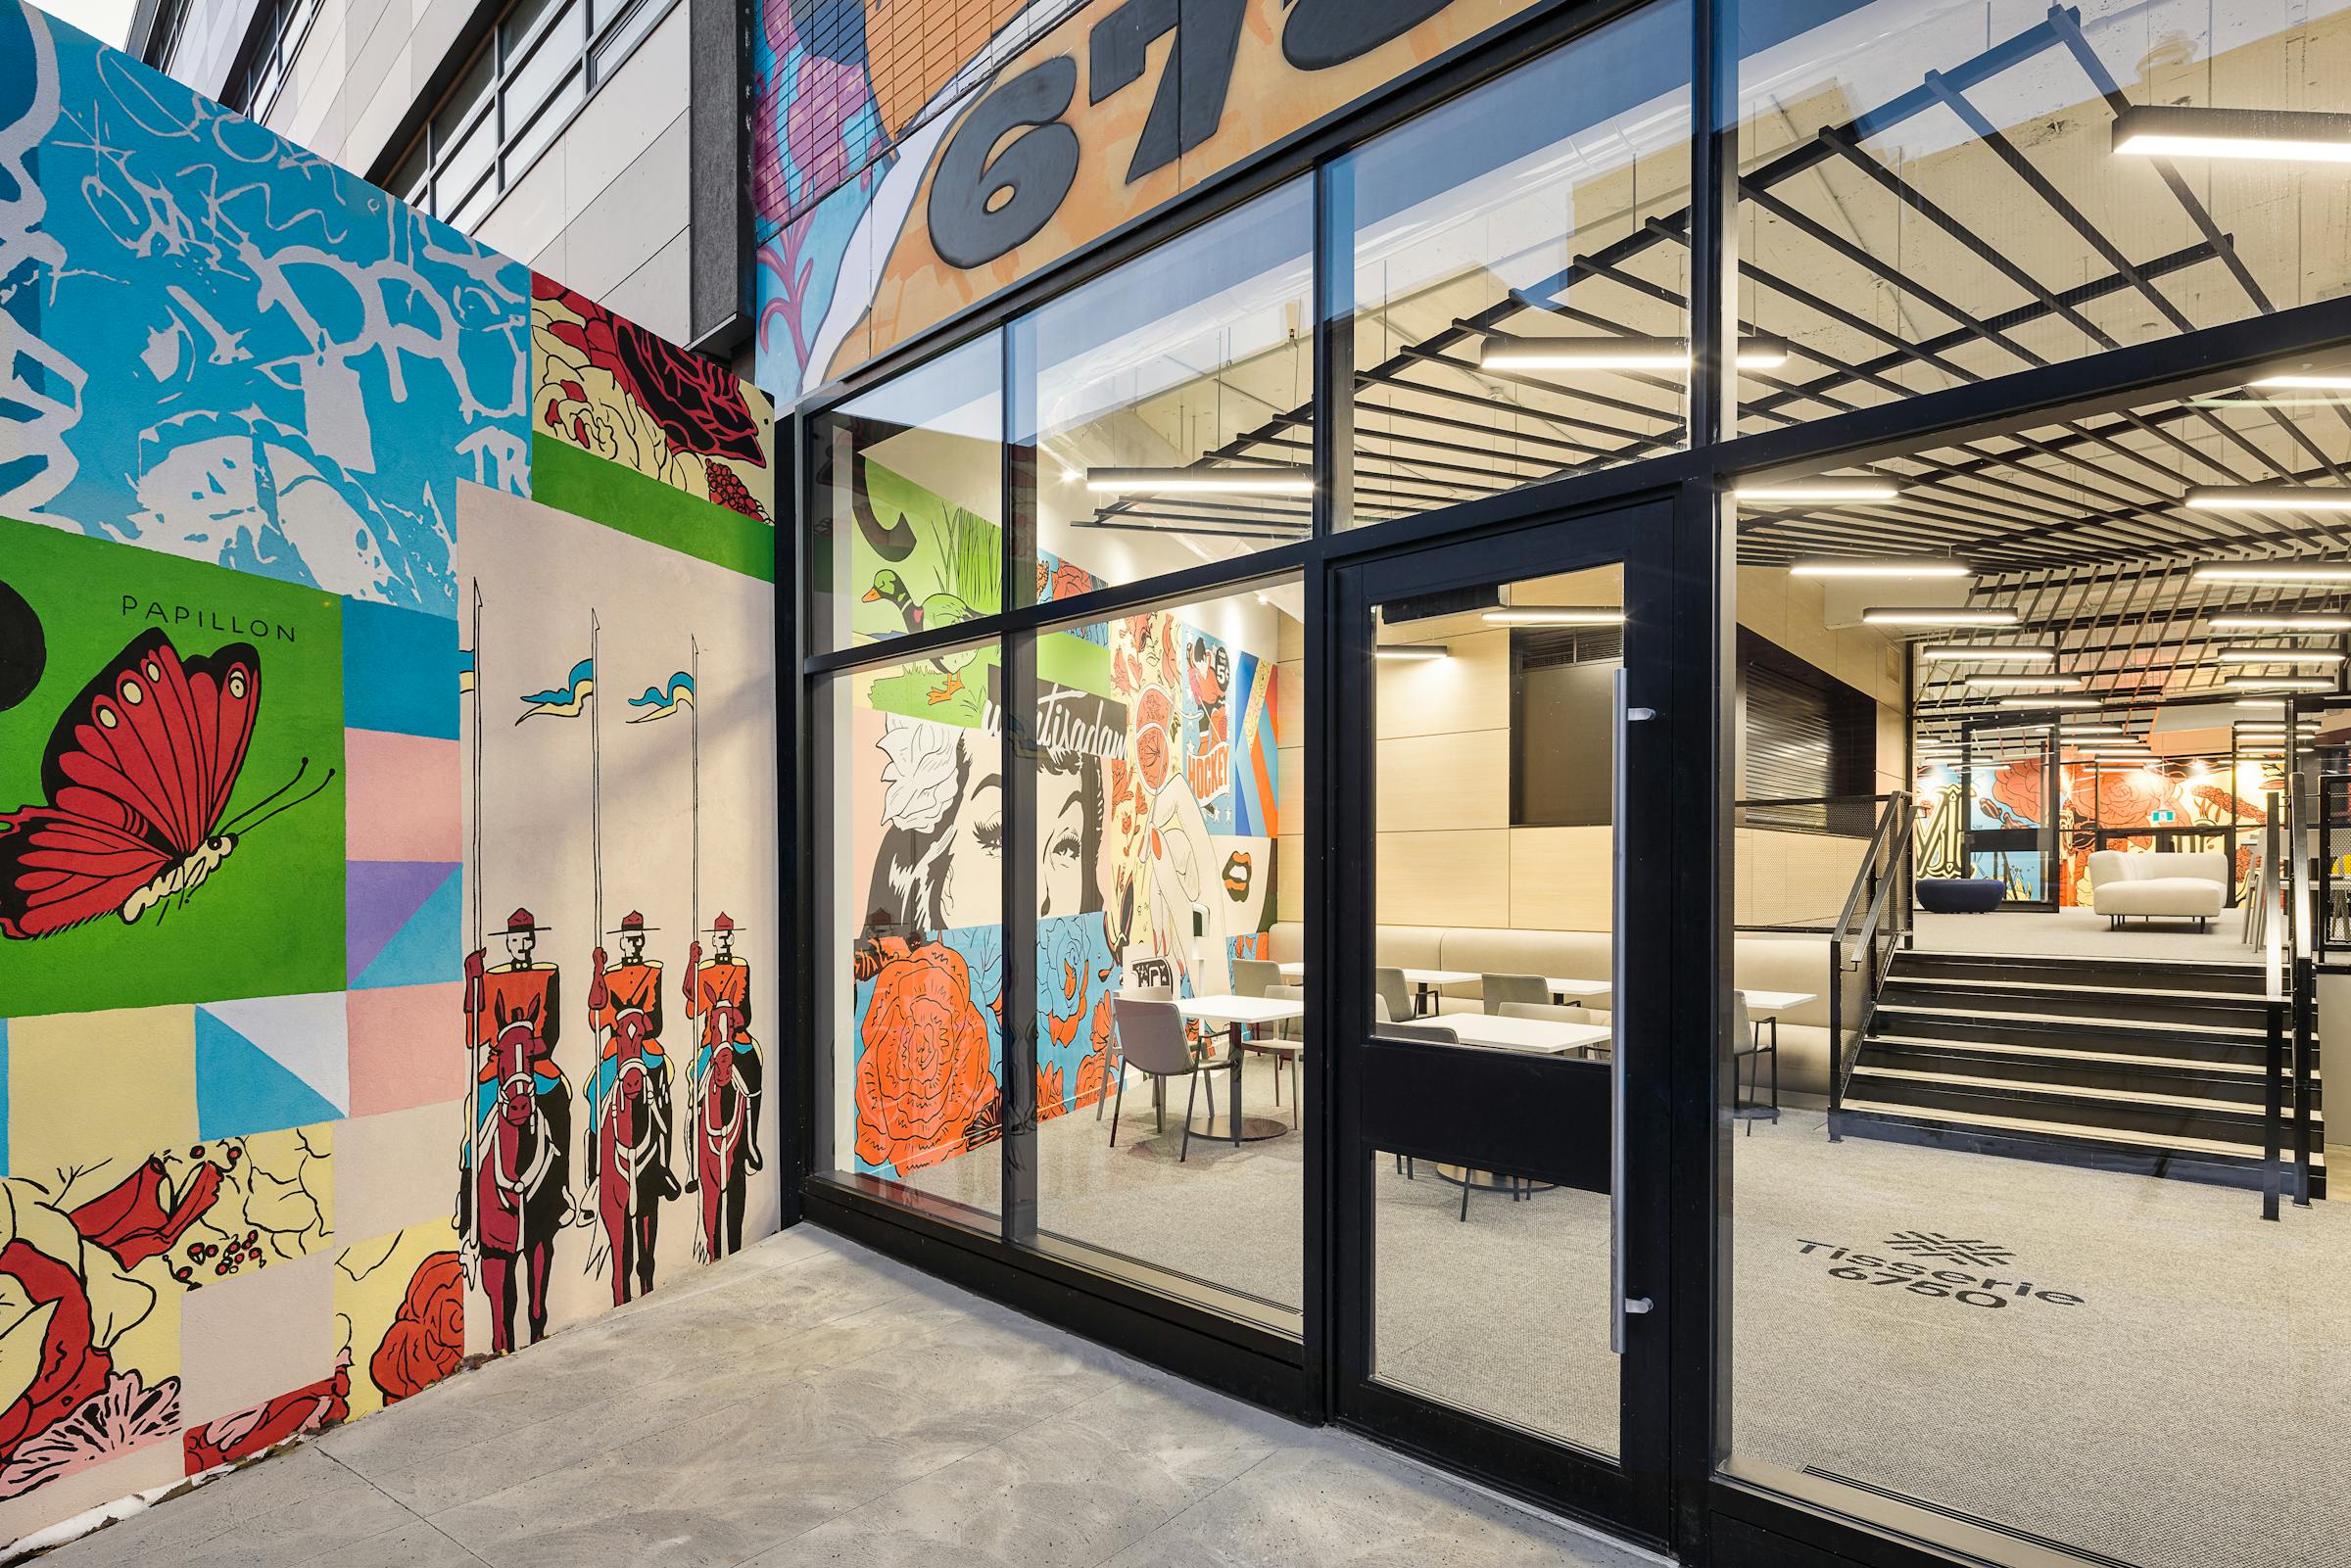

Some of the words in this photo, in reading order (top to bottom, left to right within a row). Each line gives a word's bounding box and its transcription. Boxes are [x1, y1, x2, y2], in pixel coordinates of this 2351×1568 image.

[927, 0, 1456, 270] 67
[122, 594, 295, 642] PAPILLON
[1187, 744, 1229, 800] HOCKEY
[1797, 1238, 2086, 1307] Tisserie
[1828, 1266, 2008, 1309] 6750
